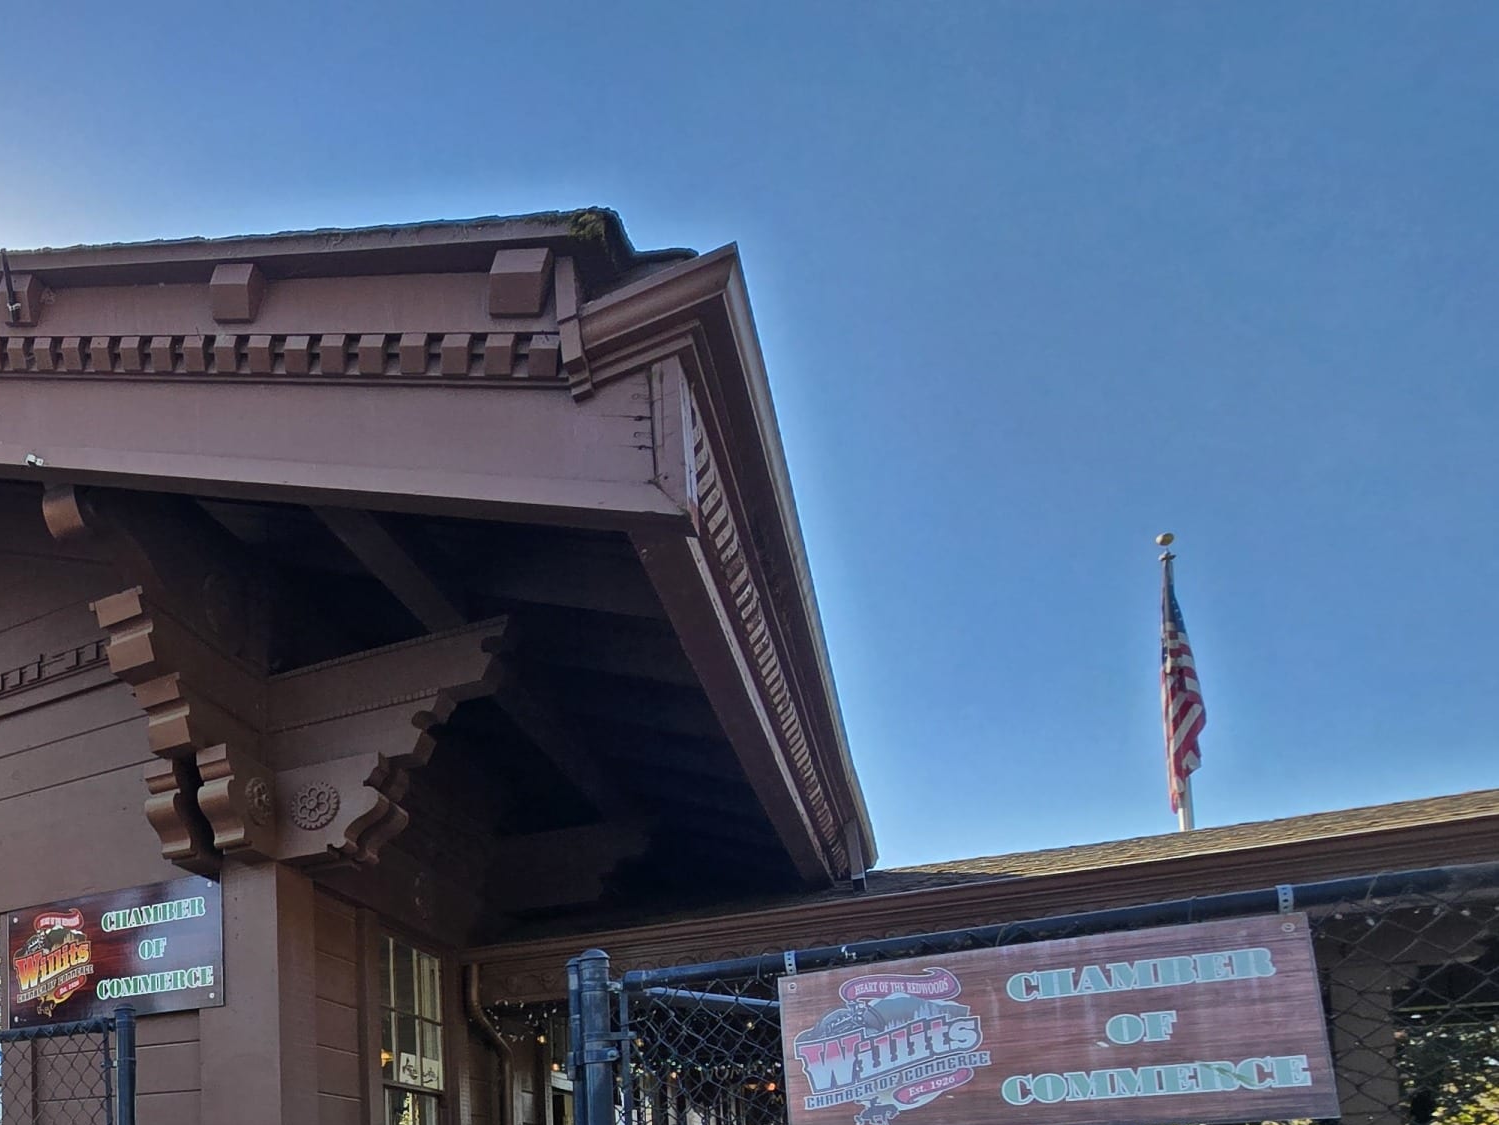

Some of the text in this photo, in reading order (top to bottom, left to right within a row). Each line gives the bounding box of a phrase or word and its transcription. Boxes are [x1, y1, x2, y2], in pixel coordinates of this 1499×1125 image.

[101, 896, 206, 932] CHAMBER
[138, 937, 167, 960] OF
[15, 943, 89, 991] Willits
[96, 966, 214, 1000] COMMERCE
[1006, 947, 1277, 1002] CHAMBER
[854, 977, 949, 996] HEART OF THE REDWOODS
[1105, 1010, 1177, 1045] OF
[798, 1018, 978, 1091] Willits
[806, 1085, 873, 1109] CHAMBER
[880, 1075, 897, 1089] OF
[904, 1052, 991, 1082] COMMERCE
[908, 1076, 955, 1097] Est. 1926
[1001, 1054, 1312, 1106] COMMERCE
